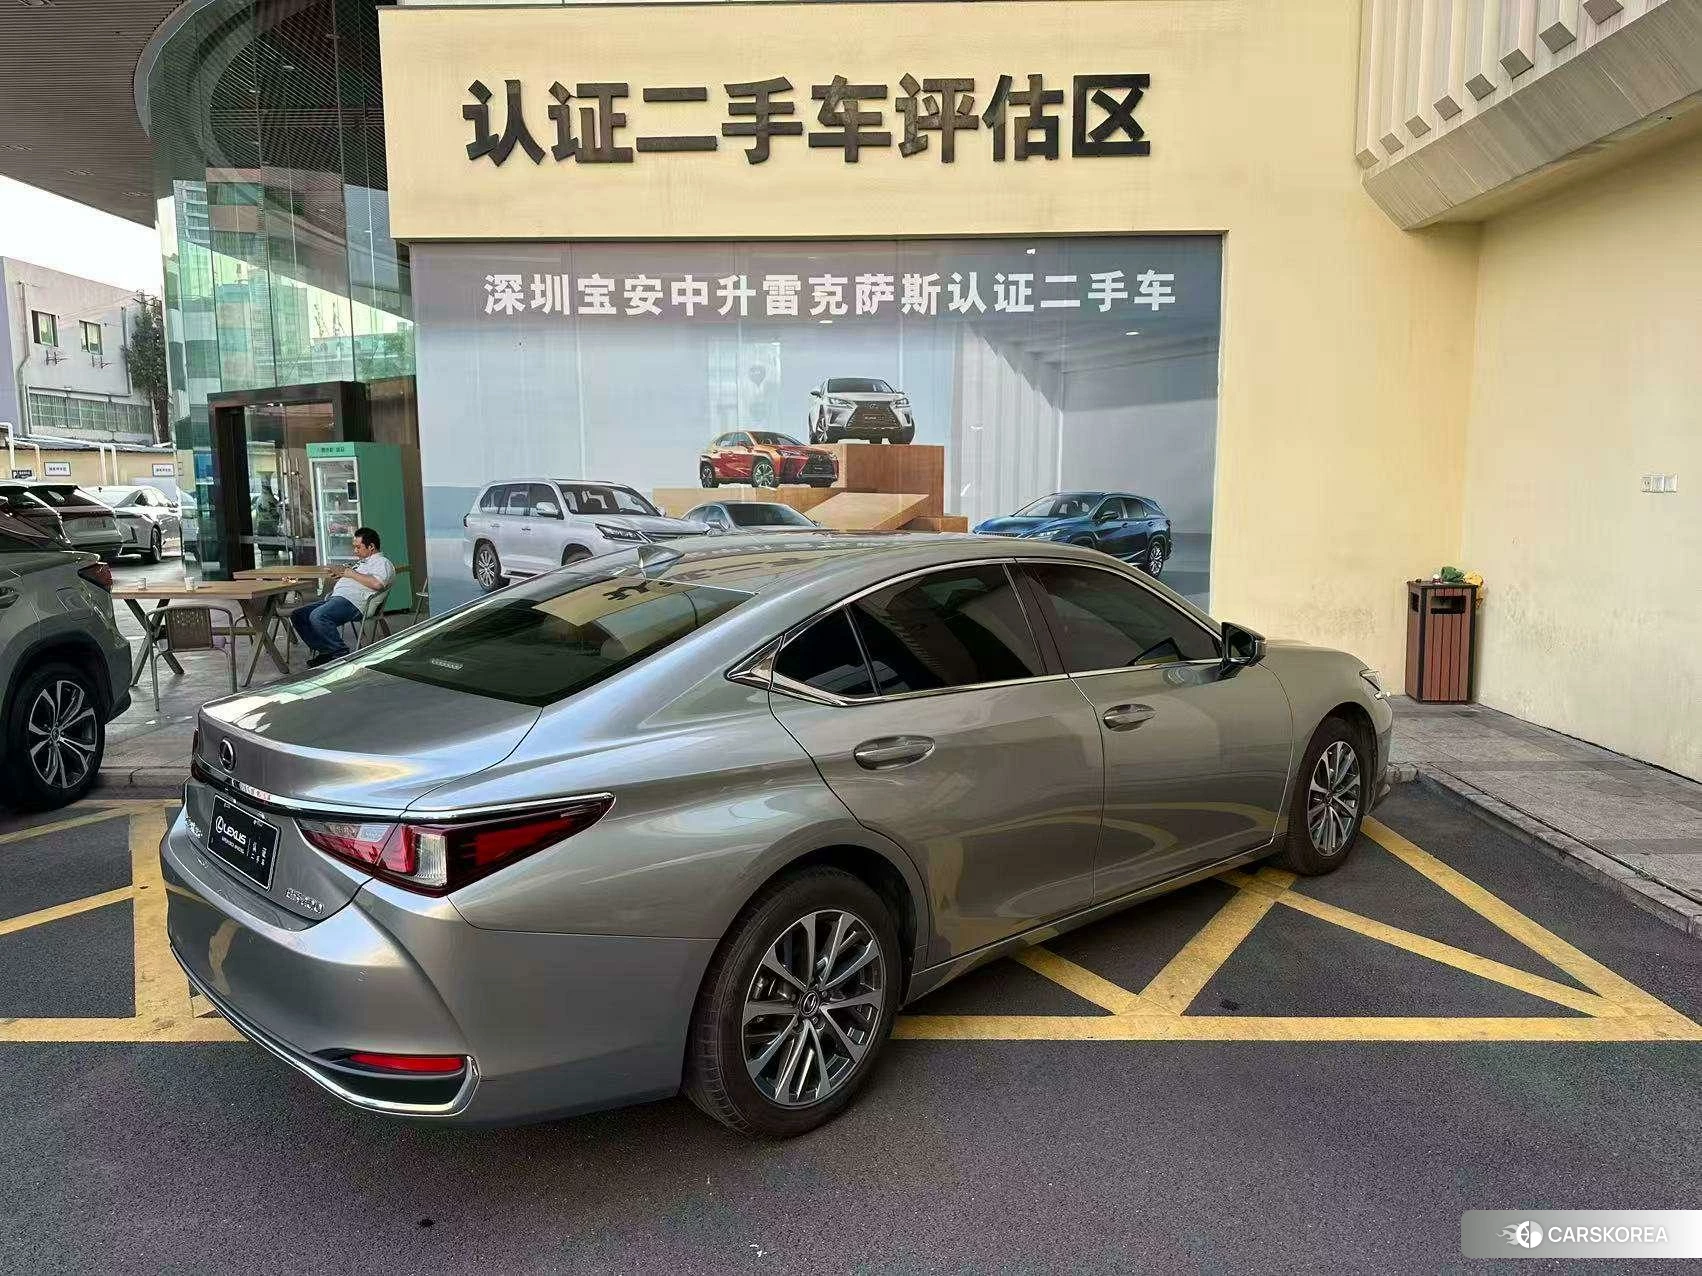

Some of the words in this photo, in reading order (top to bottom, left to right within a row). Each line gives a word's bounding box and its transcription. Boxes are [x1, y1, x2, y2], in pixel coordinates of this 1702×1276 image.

[462, 73, 1151, 167] 认证二手车评估区
[483, 269, 1177, 316] 深圳宝安中升雷克萨斯认证二手车
[223, 823, 246, 844] LEXUS
